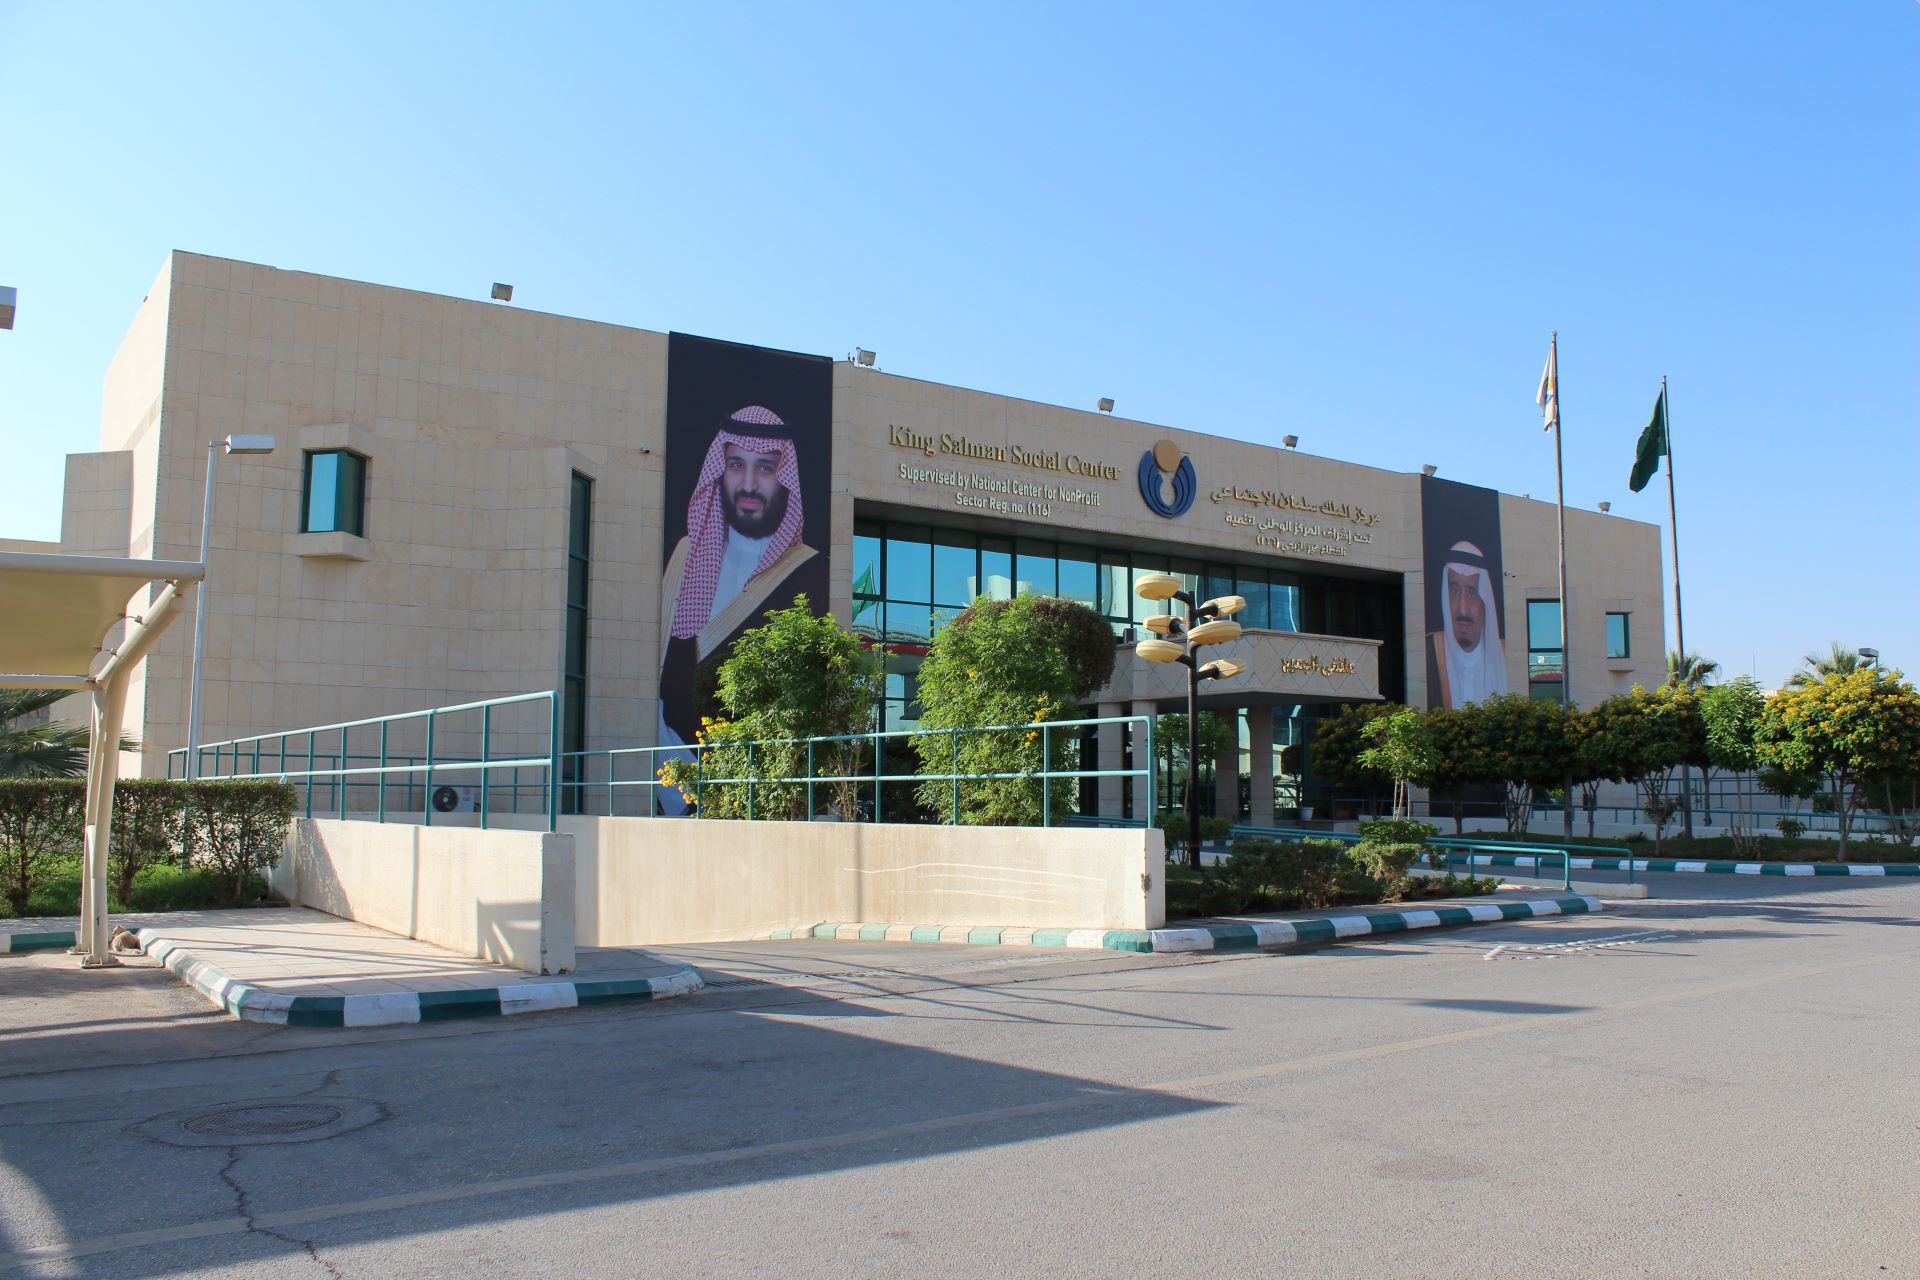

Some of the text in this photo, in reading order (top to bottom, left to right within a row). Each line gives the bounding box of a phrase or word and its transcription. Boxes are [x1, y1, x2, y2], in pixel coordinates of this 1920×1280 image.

[888, 424, 1121, 480] King Salman Social Center
[899, 463, 1100, 506] Supervised by National Center for NonProfit
[956, 493, 1051, 518] Sector Reg. no. (116)
[1210, 485, 1381, 526] مركز الملك سلمان الاجتماعي
[1294, 522, 1320, 537] المركز
